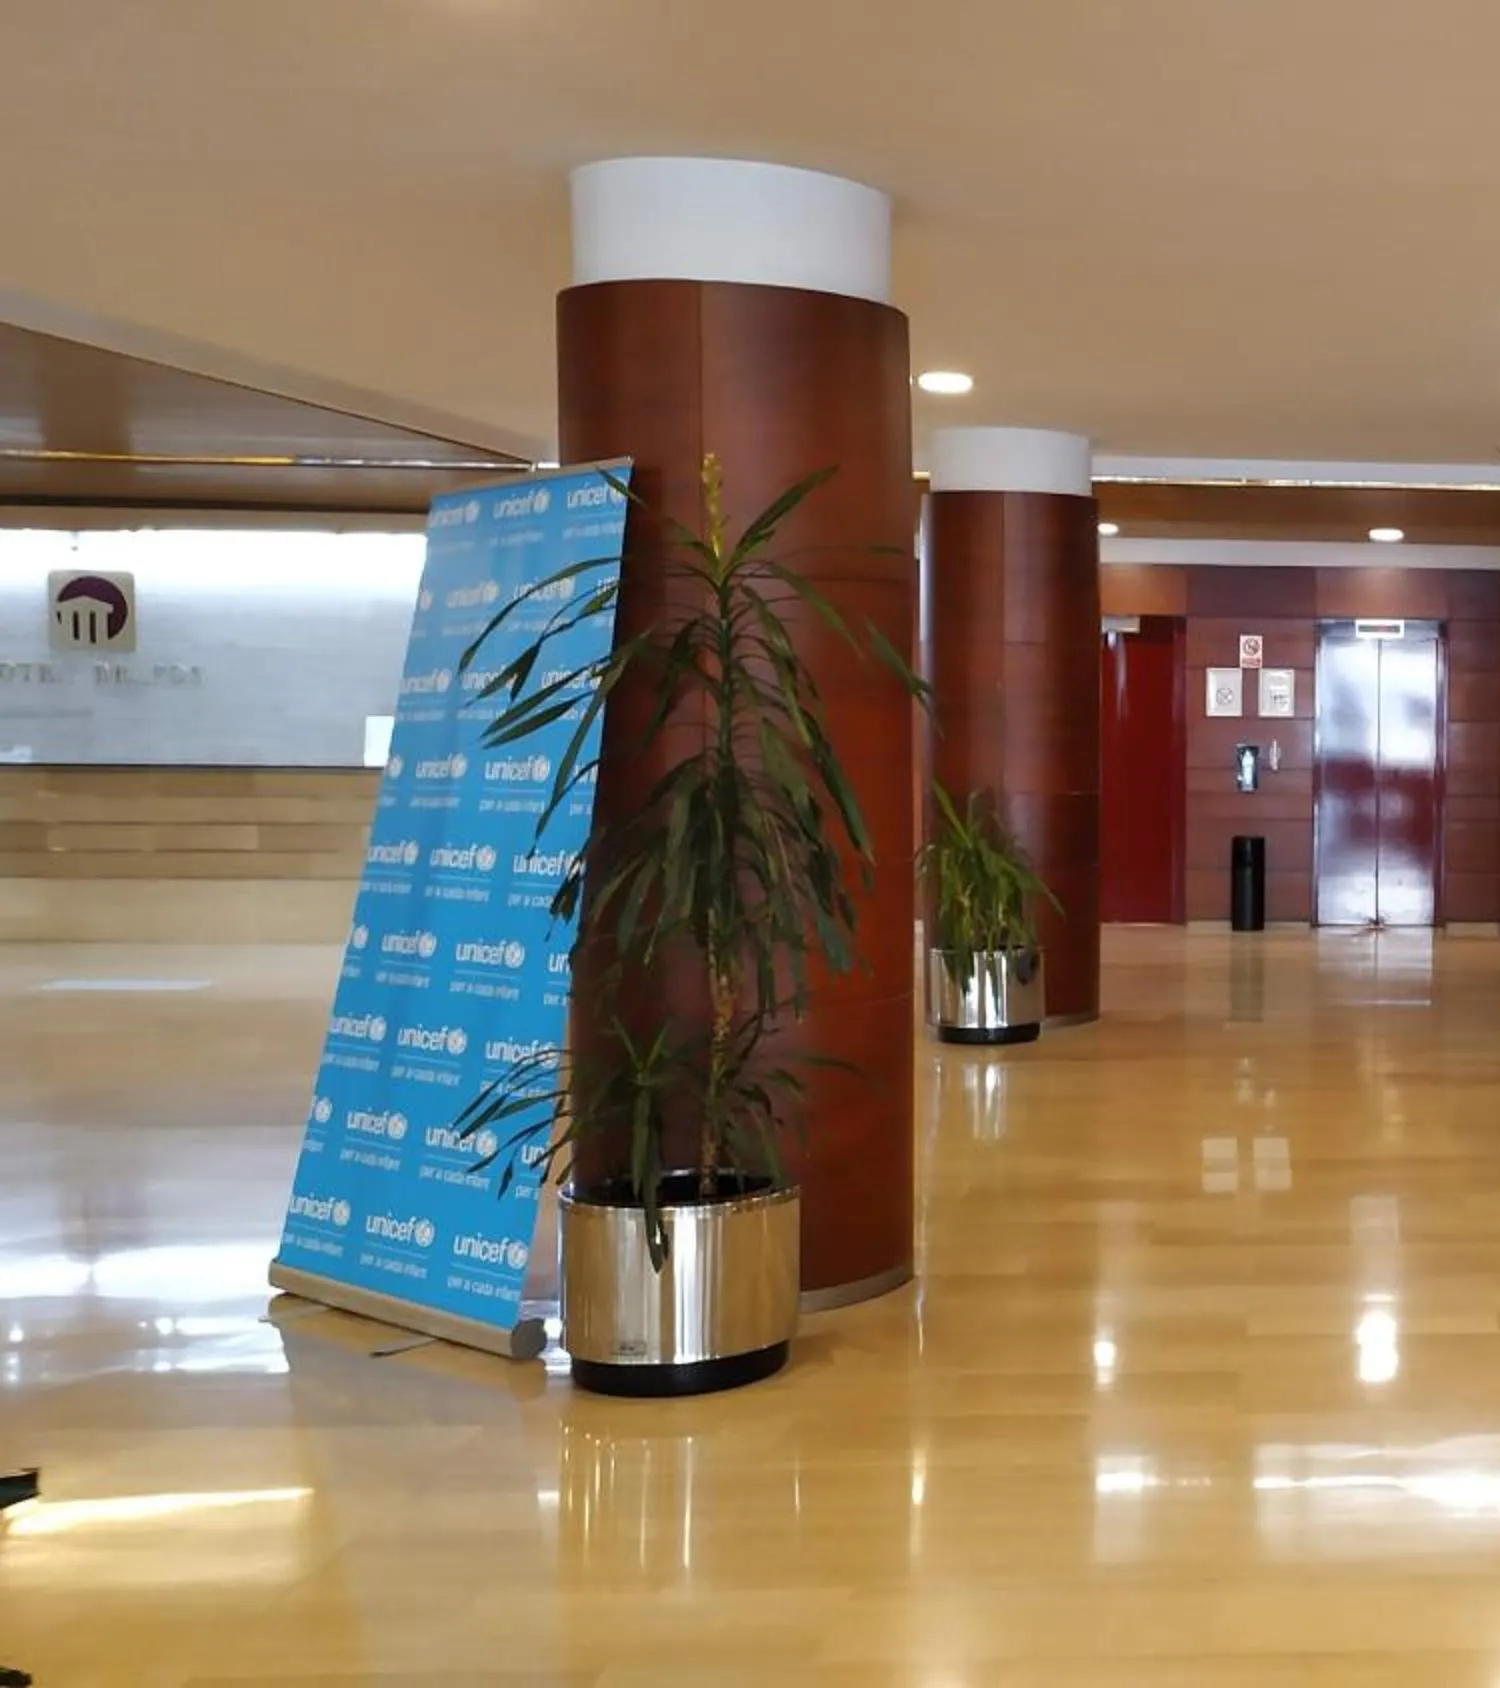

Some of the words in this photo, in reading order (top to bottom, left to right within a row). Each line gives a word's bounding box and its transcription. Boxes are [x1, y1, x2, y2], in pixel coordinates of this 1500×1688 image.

[566, 482, 609, 509] unicef
[484, 755, 535, 780] unicef
[428, 842, 475, 869] unicef
[381, 929, 420, 955] unicef
[456, 938, 506, 966] unicef
[397, 1023, 448, 1052] unicef
[346, 1105, 388, 1137] unicef
[425, 1123, 476, 1154] unicef
[289, 1192, 335, 1221] unicef
[366, 1211, 416, 1244] unicef
[453, 1231, 509, 1265] unicef
